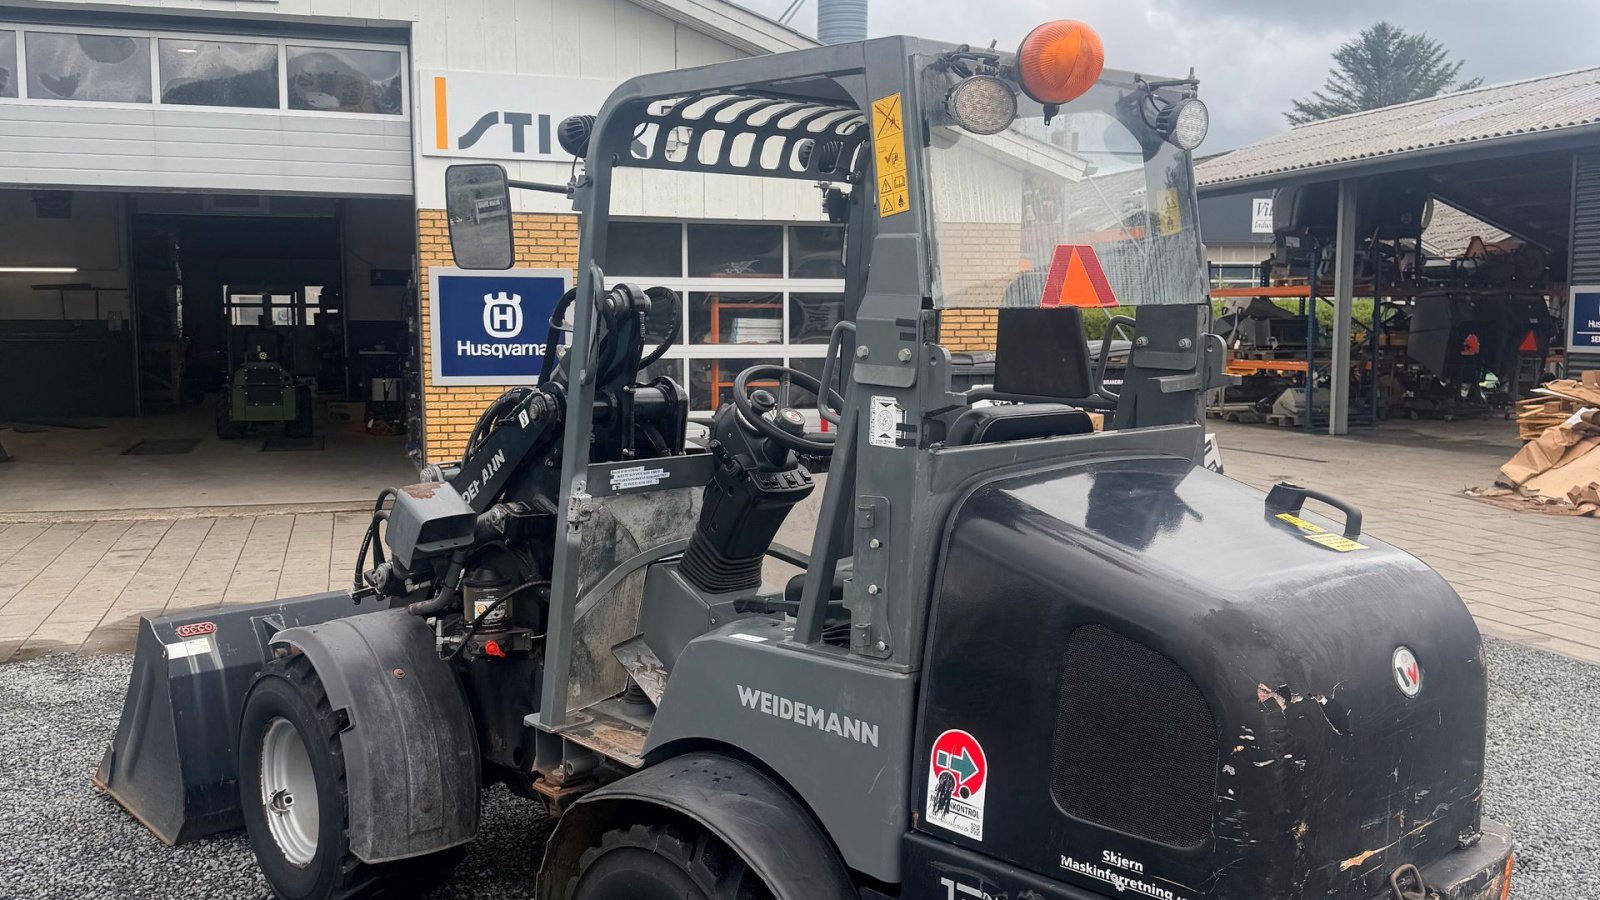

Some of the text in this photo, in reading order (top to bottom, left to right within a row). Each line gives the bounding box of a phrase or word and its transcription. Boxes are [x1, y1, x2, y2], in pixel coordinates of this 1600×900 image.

[457, 340, 547, 359] Husqvarna
[736, 684, 880, 748] WEIDEMANN
[1060, 854, 1174, 900] Maskinforretning
[1102, 849, 1144, 871] Skjern
